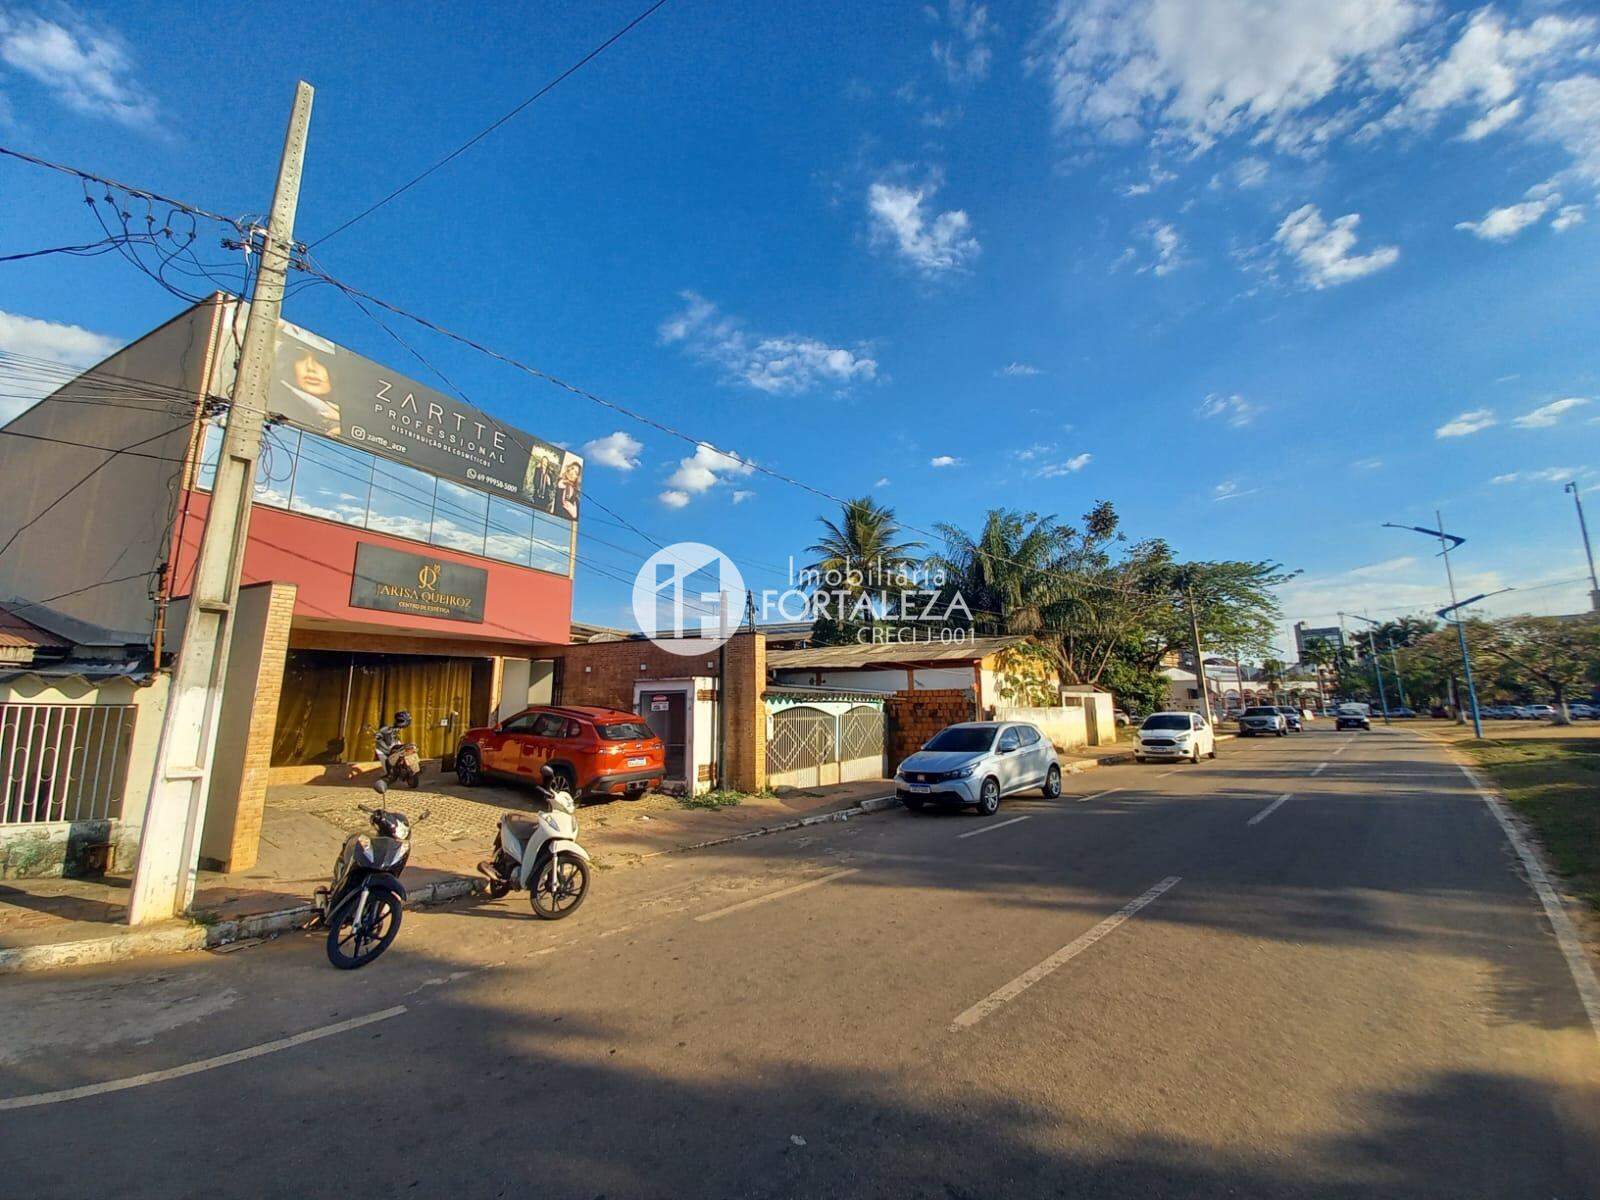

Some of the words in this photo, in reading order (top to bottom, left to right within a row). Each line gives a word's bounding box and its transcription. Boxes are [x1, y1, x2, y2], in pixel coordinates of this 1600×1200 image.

[375, 404, 505, 464] PROFESSIONAL
[376, 380, 506, 450] ZARTTE
[367, 433, 407, 453] zartte_acre
[421, 591, 472, 608] QUEIROZ
